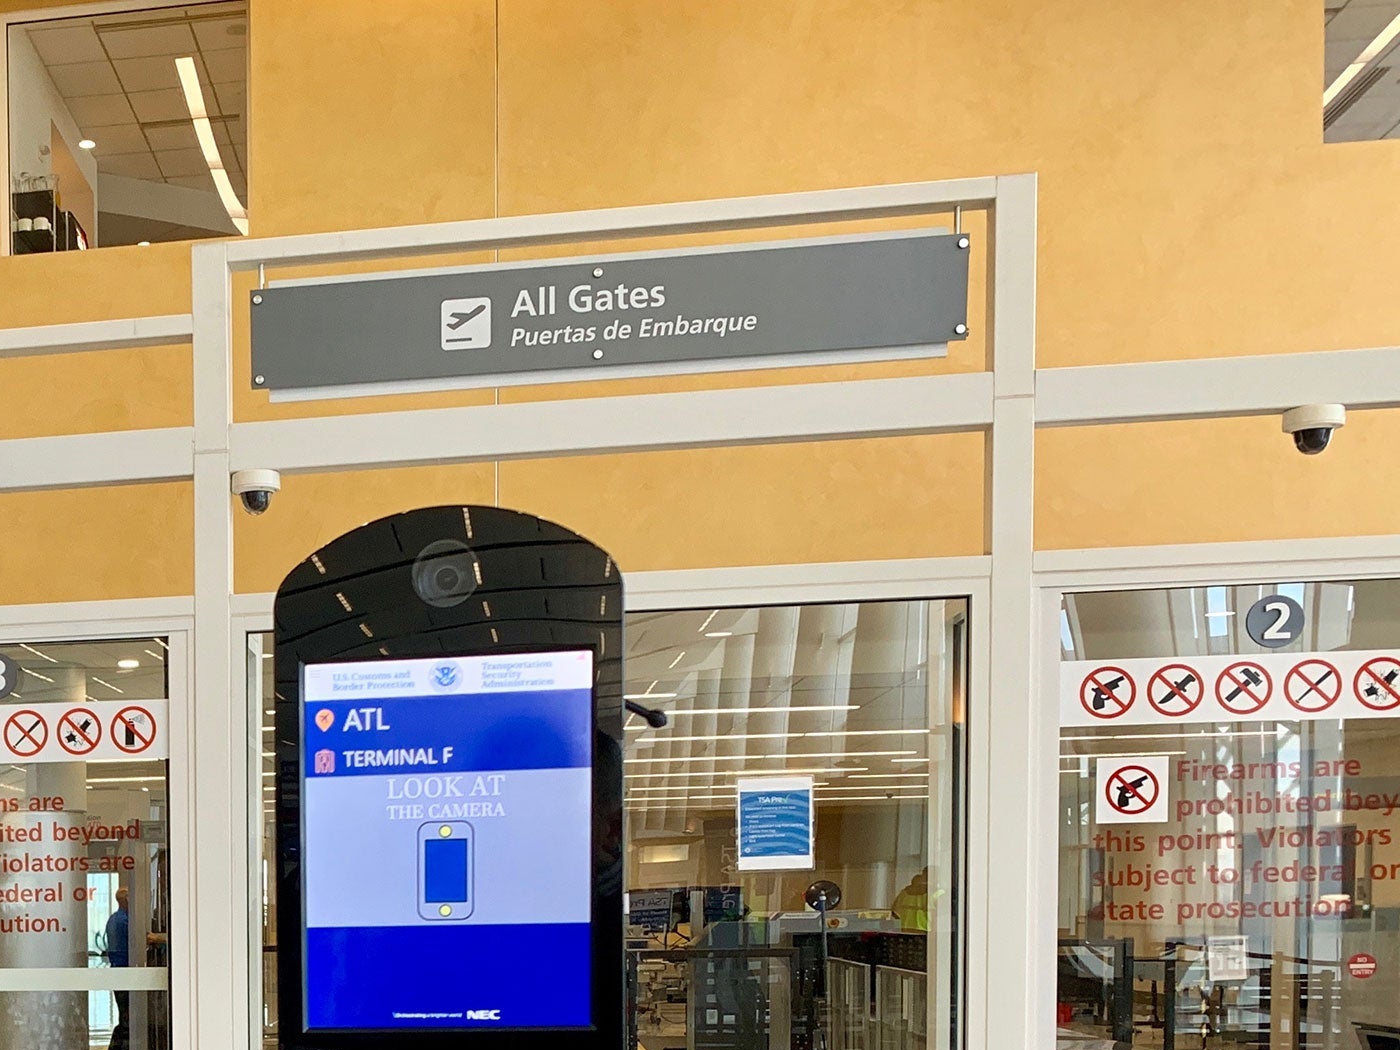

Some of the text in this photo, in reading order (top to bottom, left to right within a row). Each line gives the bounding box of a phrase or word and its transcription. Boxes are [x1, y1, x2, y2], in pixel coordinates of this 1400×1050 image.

[510, 283, 666, 318] All Gates
[510, 314, 758, 347] Puertas de Embarque
[1262, 602, 1292, 640] 2
[332, 670, 411, 682] U.S. Customs and
[481, 660, 552, 672] Transportation
[482, 671, 521, 682] Security
[332, 679, 415, 691] Border Protection
[481, 678, 555, 689] Administration
[342, 707, 391, 732] ATL
[343, 747, 453, 768] TERMINAL F
[1176, 759, 1362, 782] Firearms are
[386, 774, 506, 800] LOOK AT
[29, 796, 64, 811] are
[386, 802, 506, 820] THE CAMERA
[1176, 788, 1400, 822] prohibited bey
[53, 819, 140, 846] beyond
[1093, 826, 1392, 856] this point. Violators
[100, 854, 135, 871] are
[1092, 864, 1196, 892] subject
[1208, 868, 1239, 885] to
[73, 886, 97, 901] or
[1089, 899, 1164, 922] state
[467, 1010, 500, 1020] NEC
